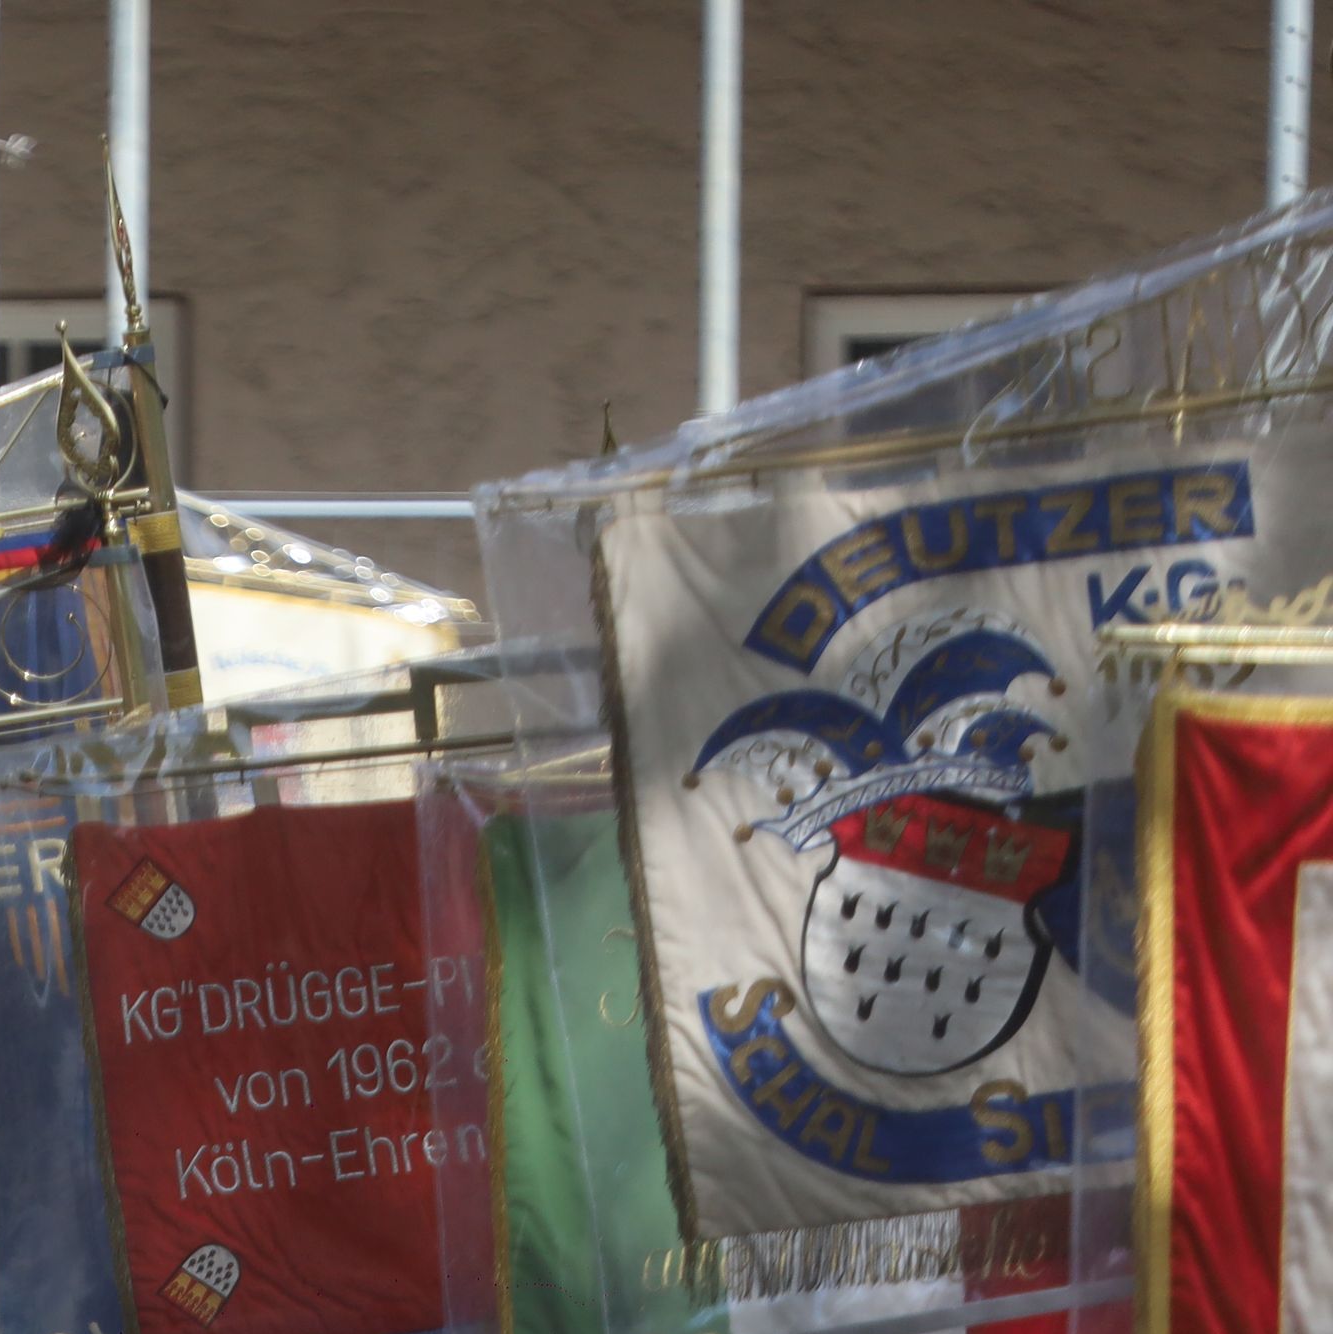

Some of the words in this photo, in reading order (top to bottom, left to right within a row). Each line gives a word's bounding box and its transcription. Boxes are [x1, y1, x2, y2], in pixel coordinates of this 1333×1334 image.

[760, 472, 1236, 664] DEUTZER
[213, 1066, 313, 1114] von
[326, 1032, 458, 1102] 1962
[174, 1122, 487, 1200] Köln-Ehren
